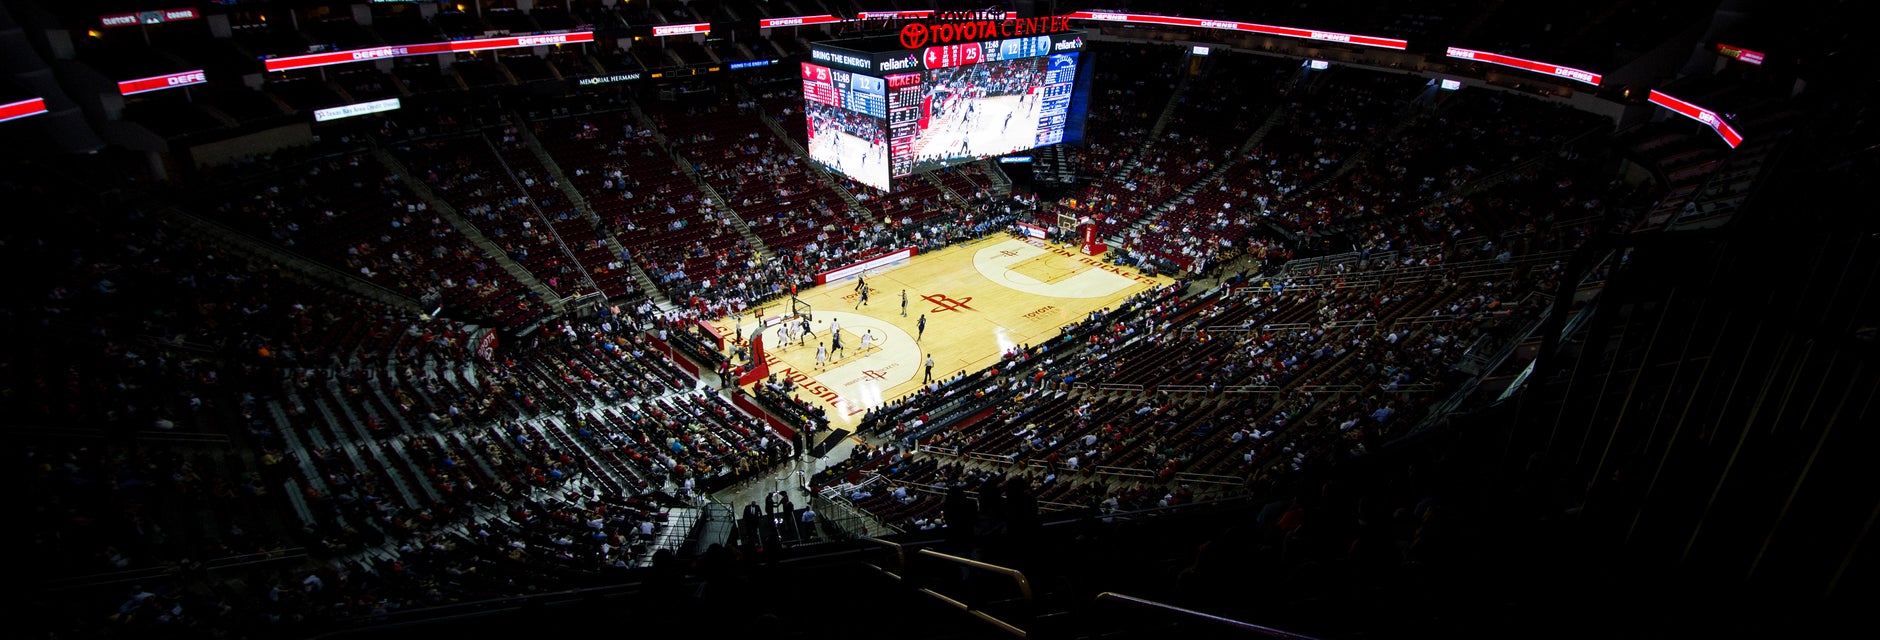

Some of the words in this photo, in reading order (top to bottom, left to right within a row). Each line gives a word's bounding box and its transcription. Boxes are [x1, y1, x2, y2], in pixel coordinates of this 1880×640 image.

[656, 26, 695, 34] DEFENSE
[930, 21, 997, 43] TOYOTA
[1001, 16, 1070, 36] CENTER
[1201, 20, 1237, 29] DEFENSE
[518, 35, 566, 45] DEFENSE
[1311, 32, 1350, 42] DEFENSE
[1008, 44, 1017, 54] 12
[1055, 40, 1076, 50] reliant
[353, 48, 408, 60] DEFENSE
[813, 49, 830, 60] BRING
[831, 53, 843, 63] THE
[844, 56, 871, 69] ENERGY!
[966, 48, 976, 60] 25
[880, 57, 909, 71] reliant
[168, 73, 206, 85] DEFE
[580, 77, 609, 86] MEMORIAL
[610, 73, 640, 82] HERMANN
[816, 68, 826, 80] 25
[833, 72, 850, 83] 11:48
[1555, 68, 1593, 82] DEFENSE
[861, 77, 870, 89] 12
[1022, 305, 1055, 318] TOYOTA
